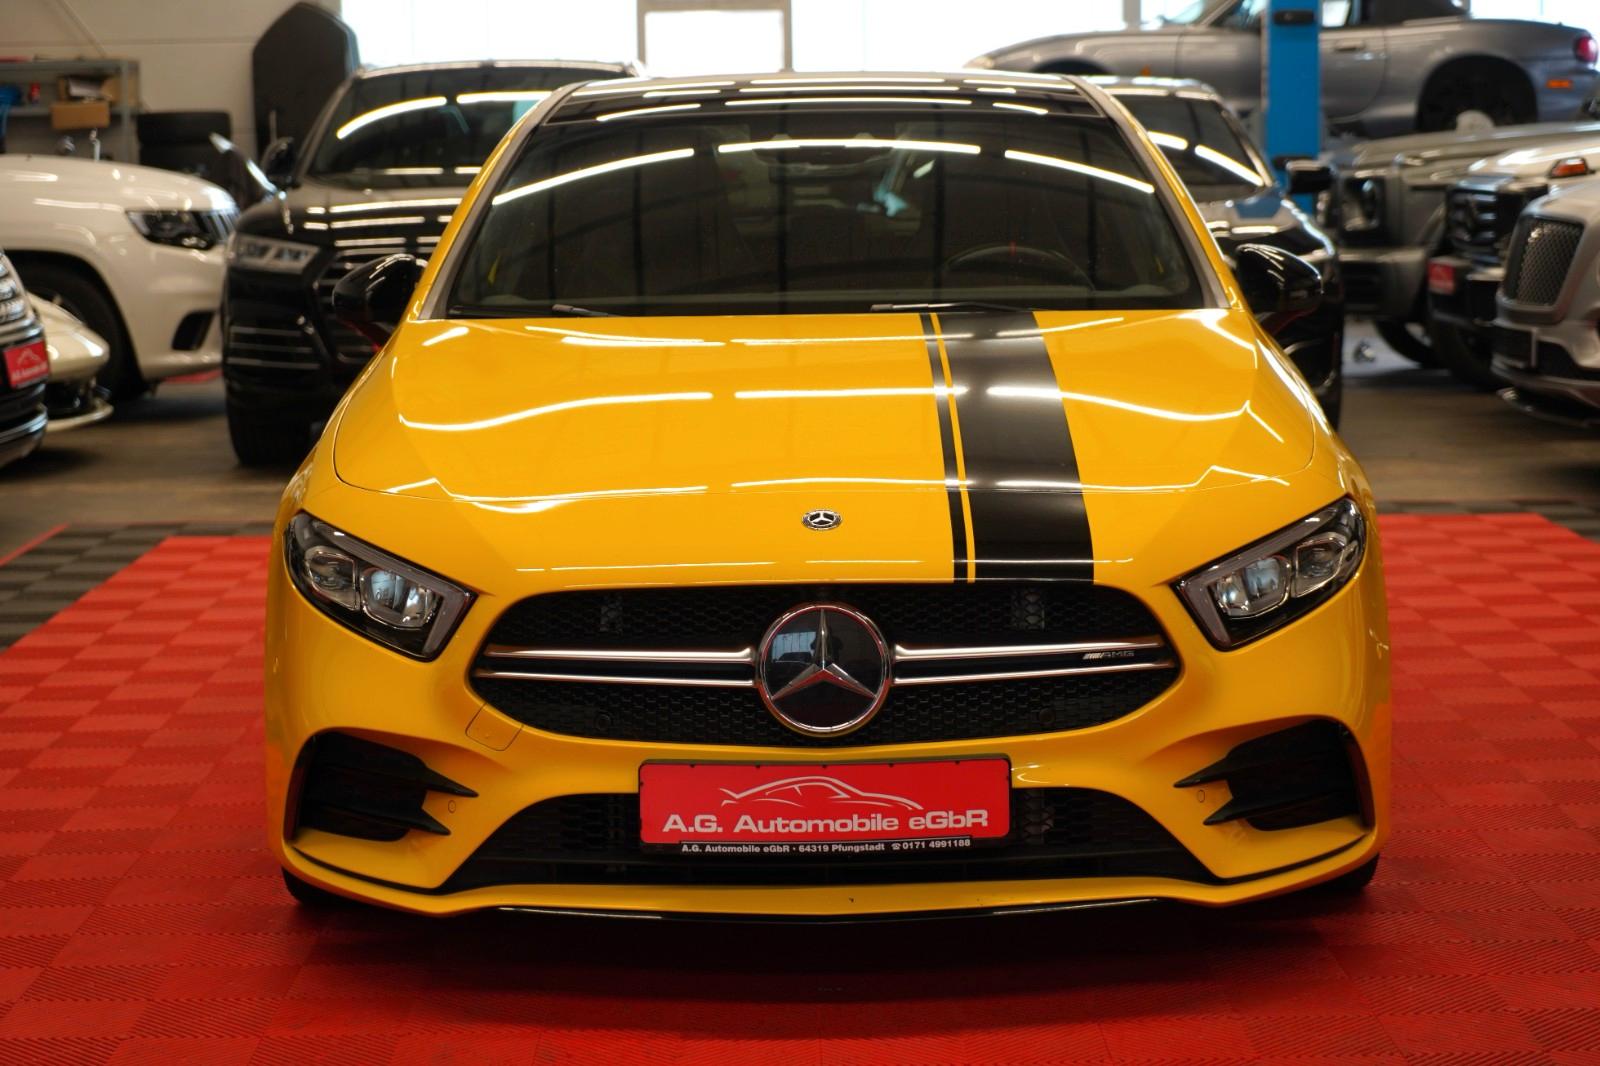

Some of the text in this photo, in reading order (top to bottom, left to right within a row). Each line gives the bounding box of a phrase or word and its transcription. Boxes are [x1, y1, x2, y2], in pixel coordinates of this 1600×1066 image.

[662, 809, 988, 833] A.G. Automobile eGbR
[681, 838, 971, 853] A.G. Automobile eGbR 64319 Pfungstadt 0171 4991188
